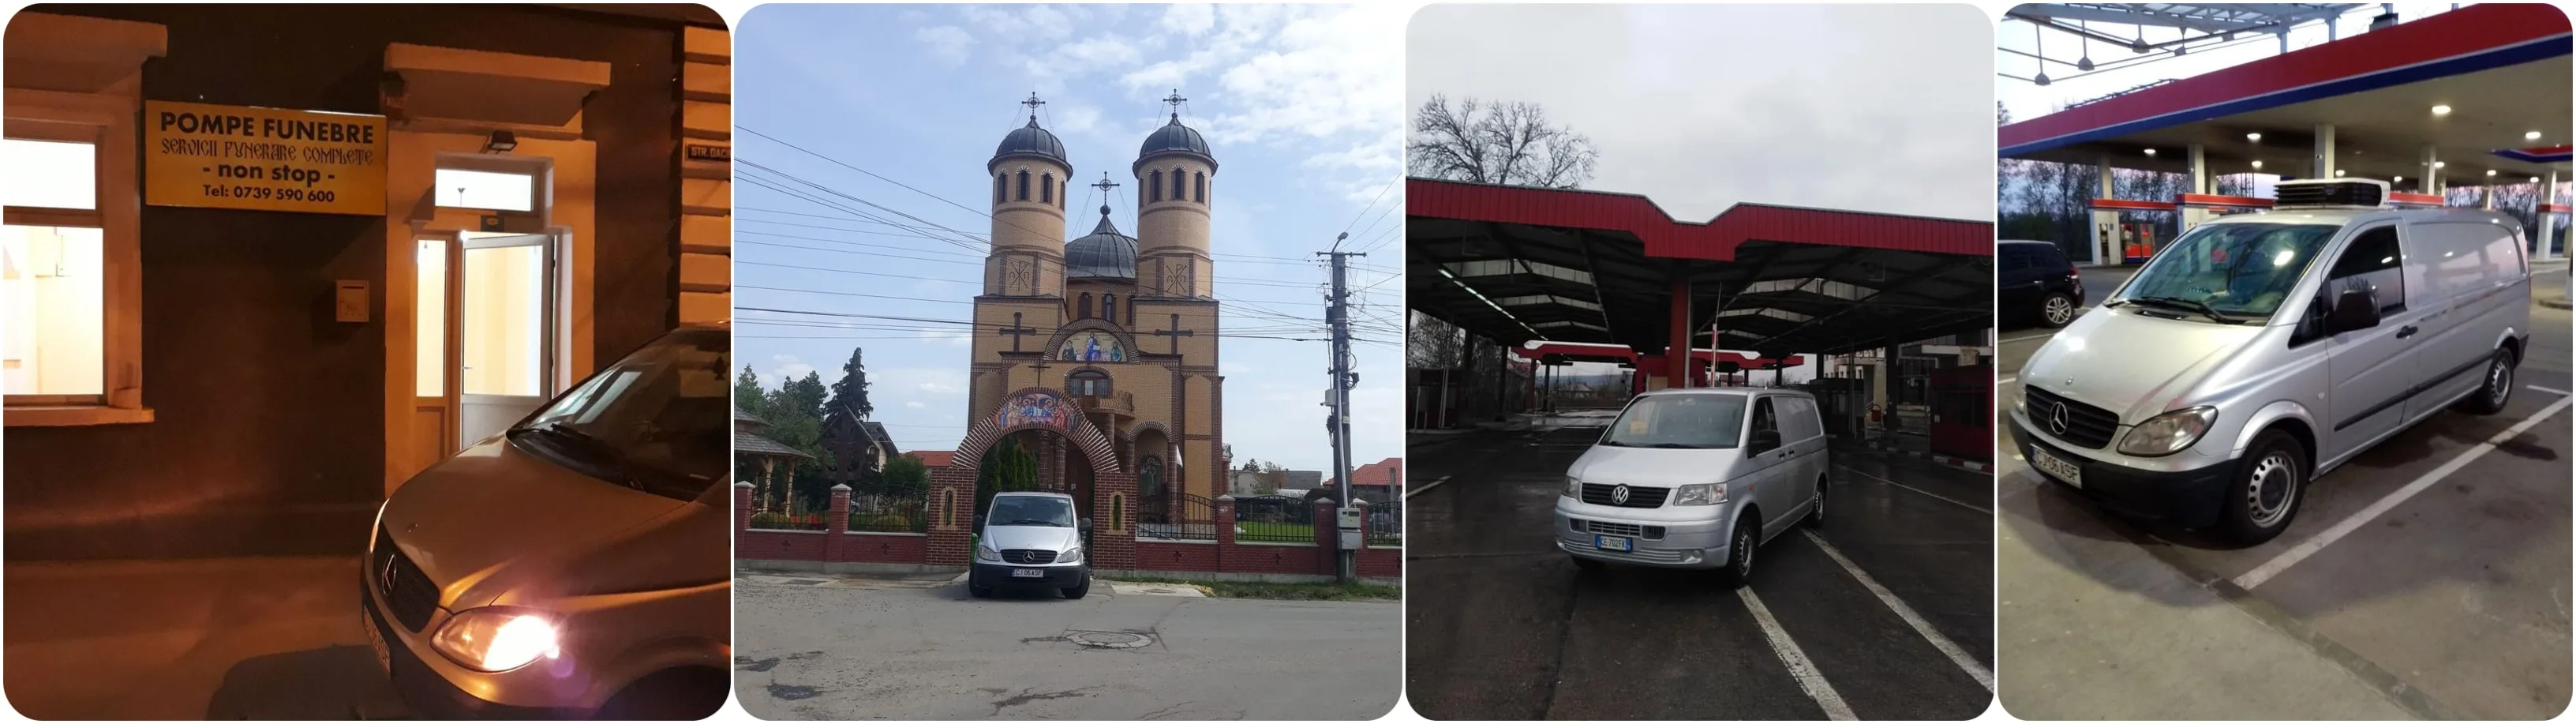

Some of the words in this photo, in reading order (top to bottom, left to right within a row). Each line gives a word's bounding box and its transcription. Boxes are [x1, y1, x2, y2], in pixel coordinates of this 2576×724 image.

[160, 111, 255, 137] POMPE
[263, 118, 374, 144] FUNEBRE
[162, 137, 218, 157] SERVICII
[224, 141, 297, 161] FUNERARE
[303, 147, 373, 166] COMPLETE
[218, 163, 263, 179] non
[271, 165, 321, 187] stop
[203, 184, 229, 197] Tel:
[233, 186, 271, 199] 0739
[276, 189, 303, 201] 590
[308, 189, 335, 202] 600
